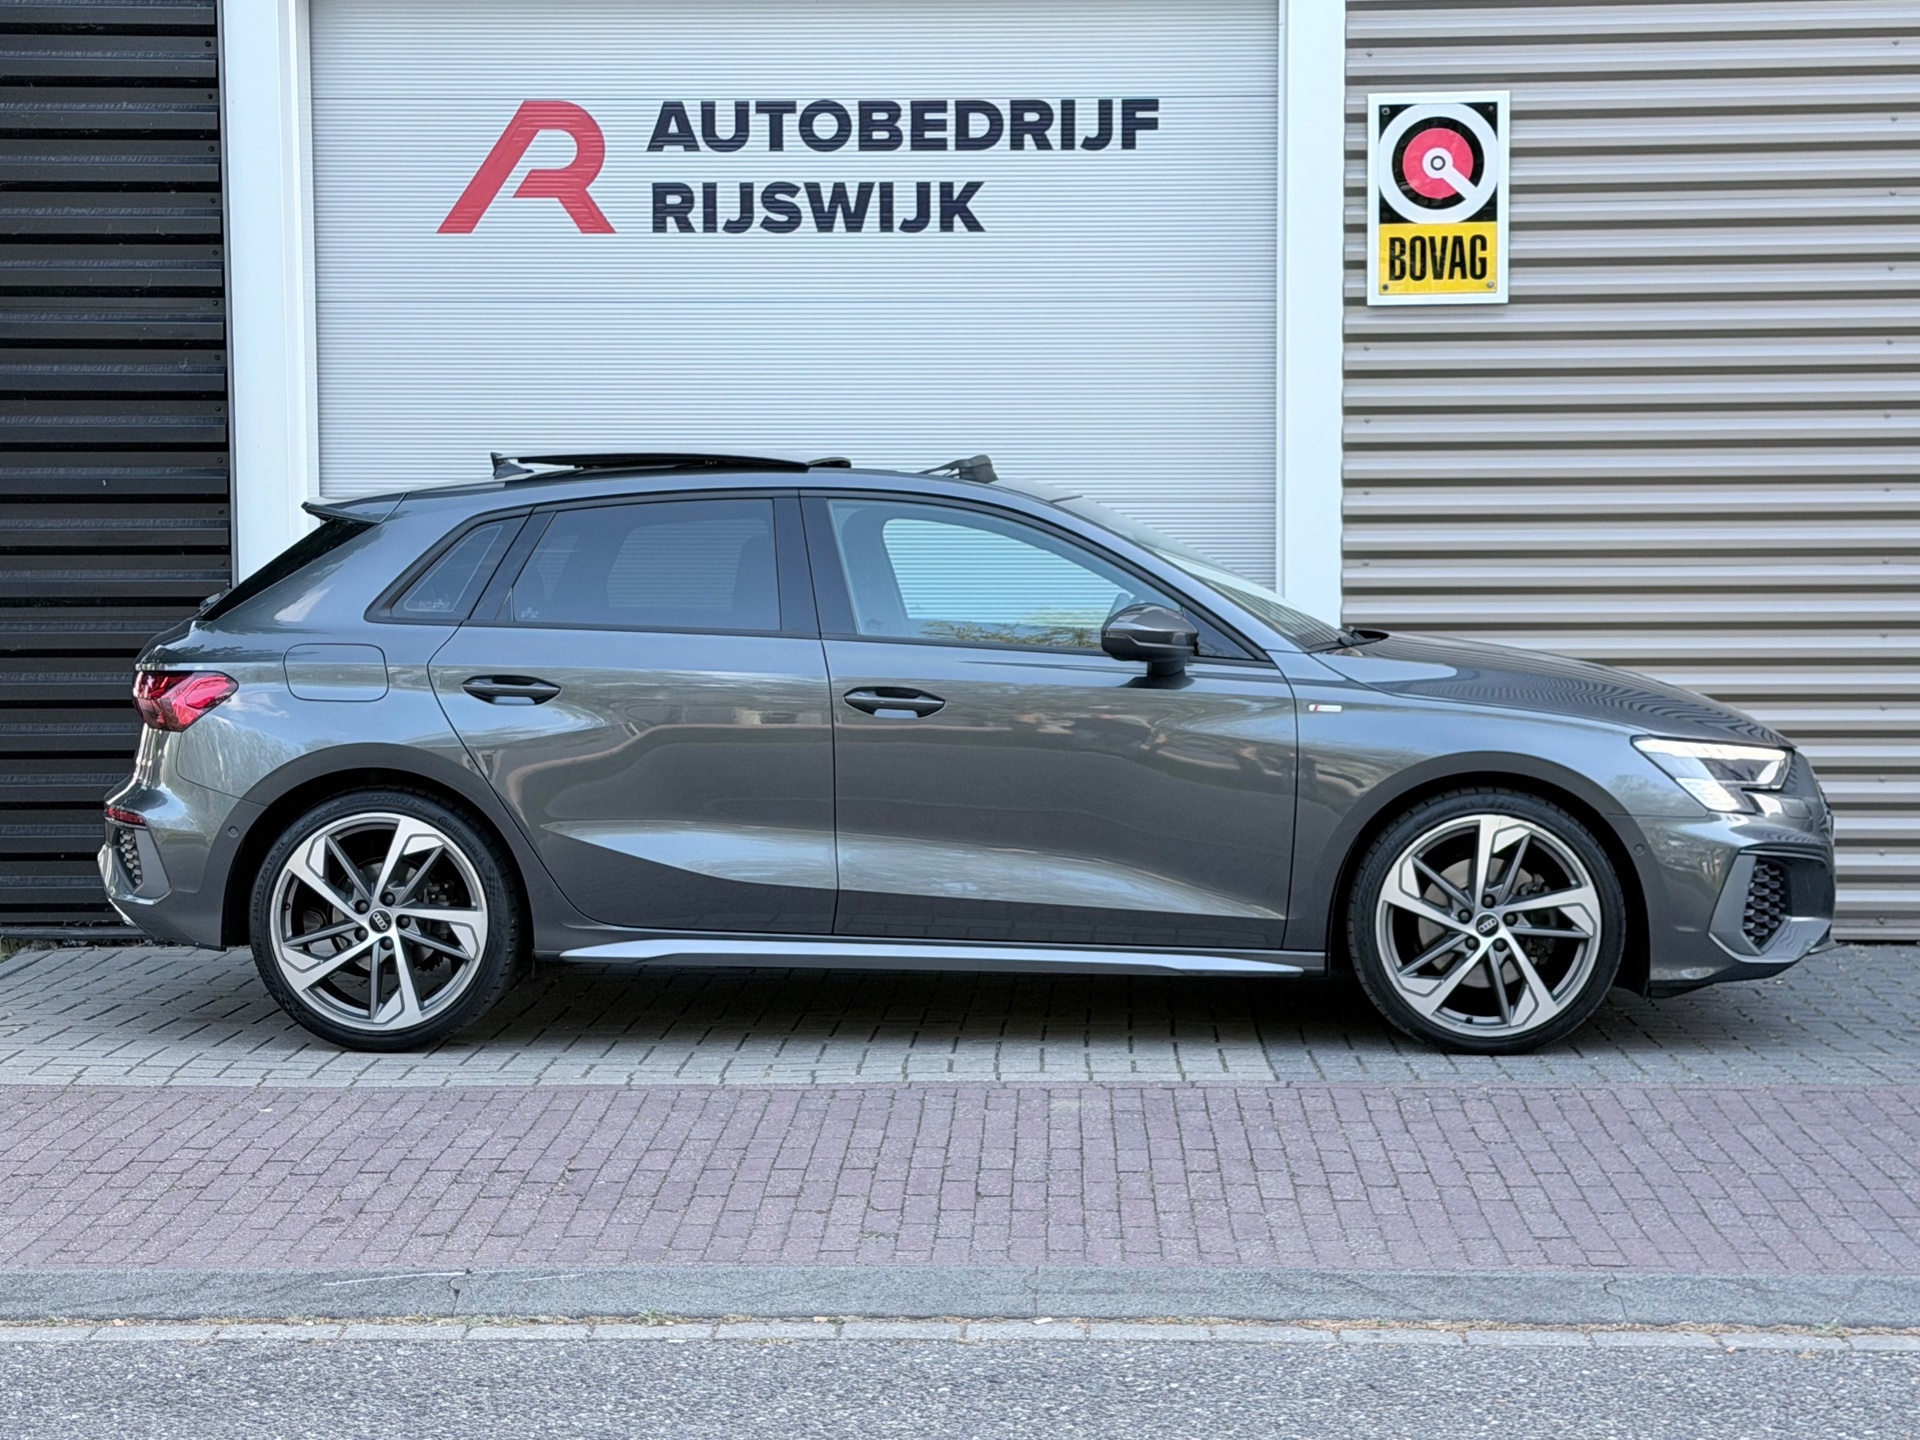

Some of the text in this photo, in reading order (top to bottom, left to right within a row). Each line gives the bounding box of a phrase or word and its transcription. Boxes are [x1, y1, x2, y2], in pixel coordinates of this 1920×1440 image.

[646, 98, 1160, 153] AUTOBEDRIJF
[651, 181, 986, 234] RIJSWIJK
[1389, 235, 1487, 281] BOVAG
